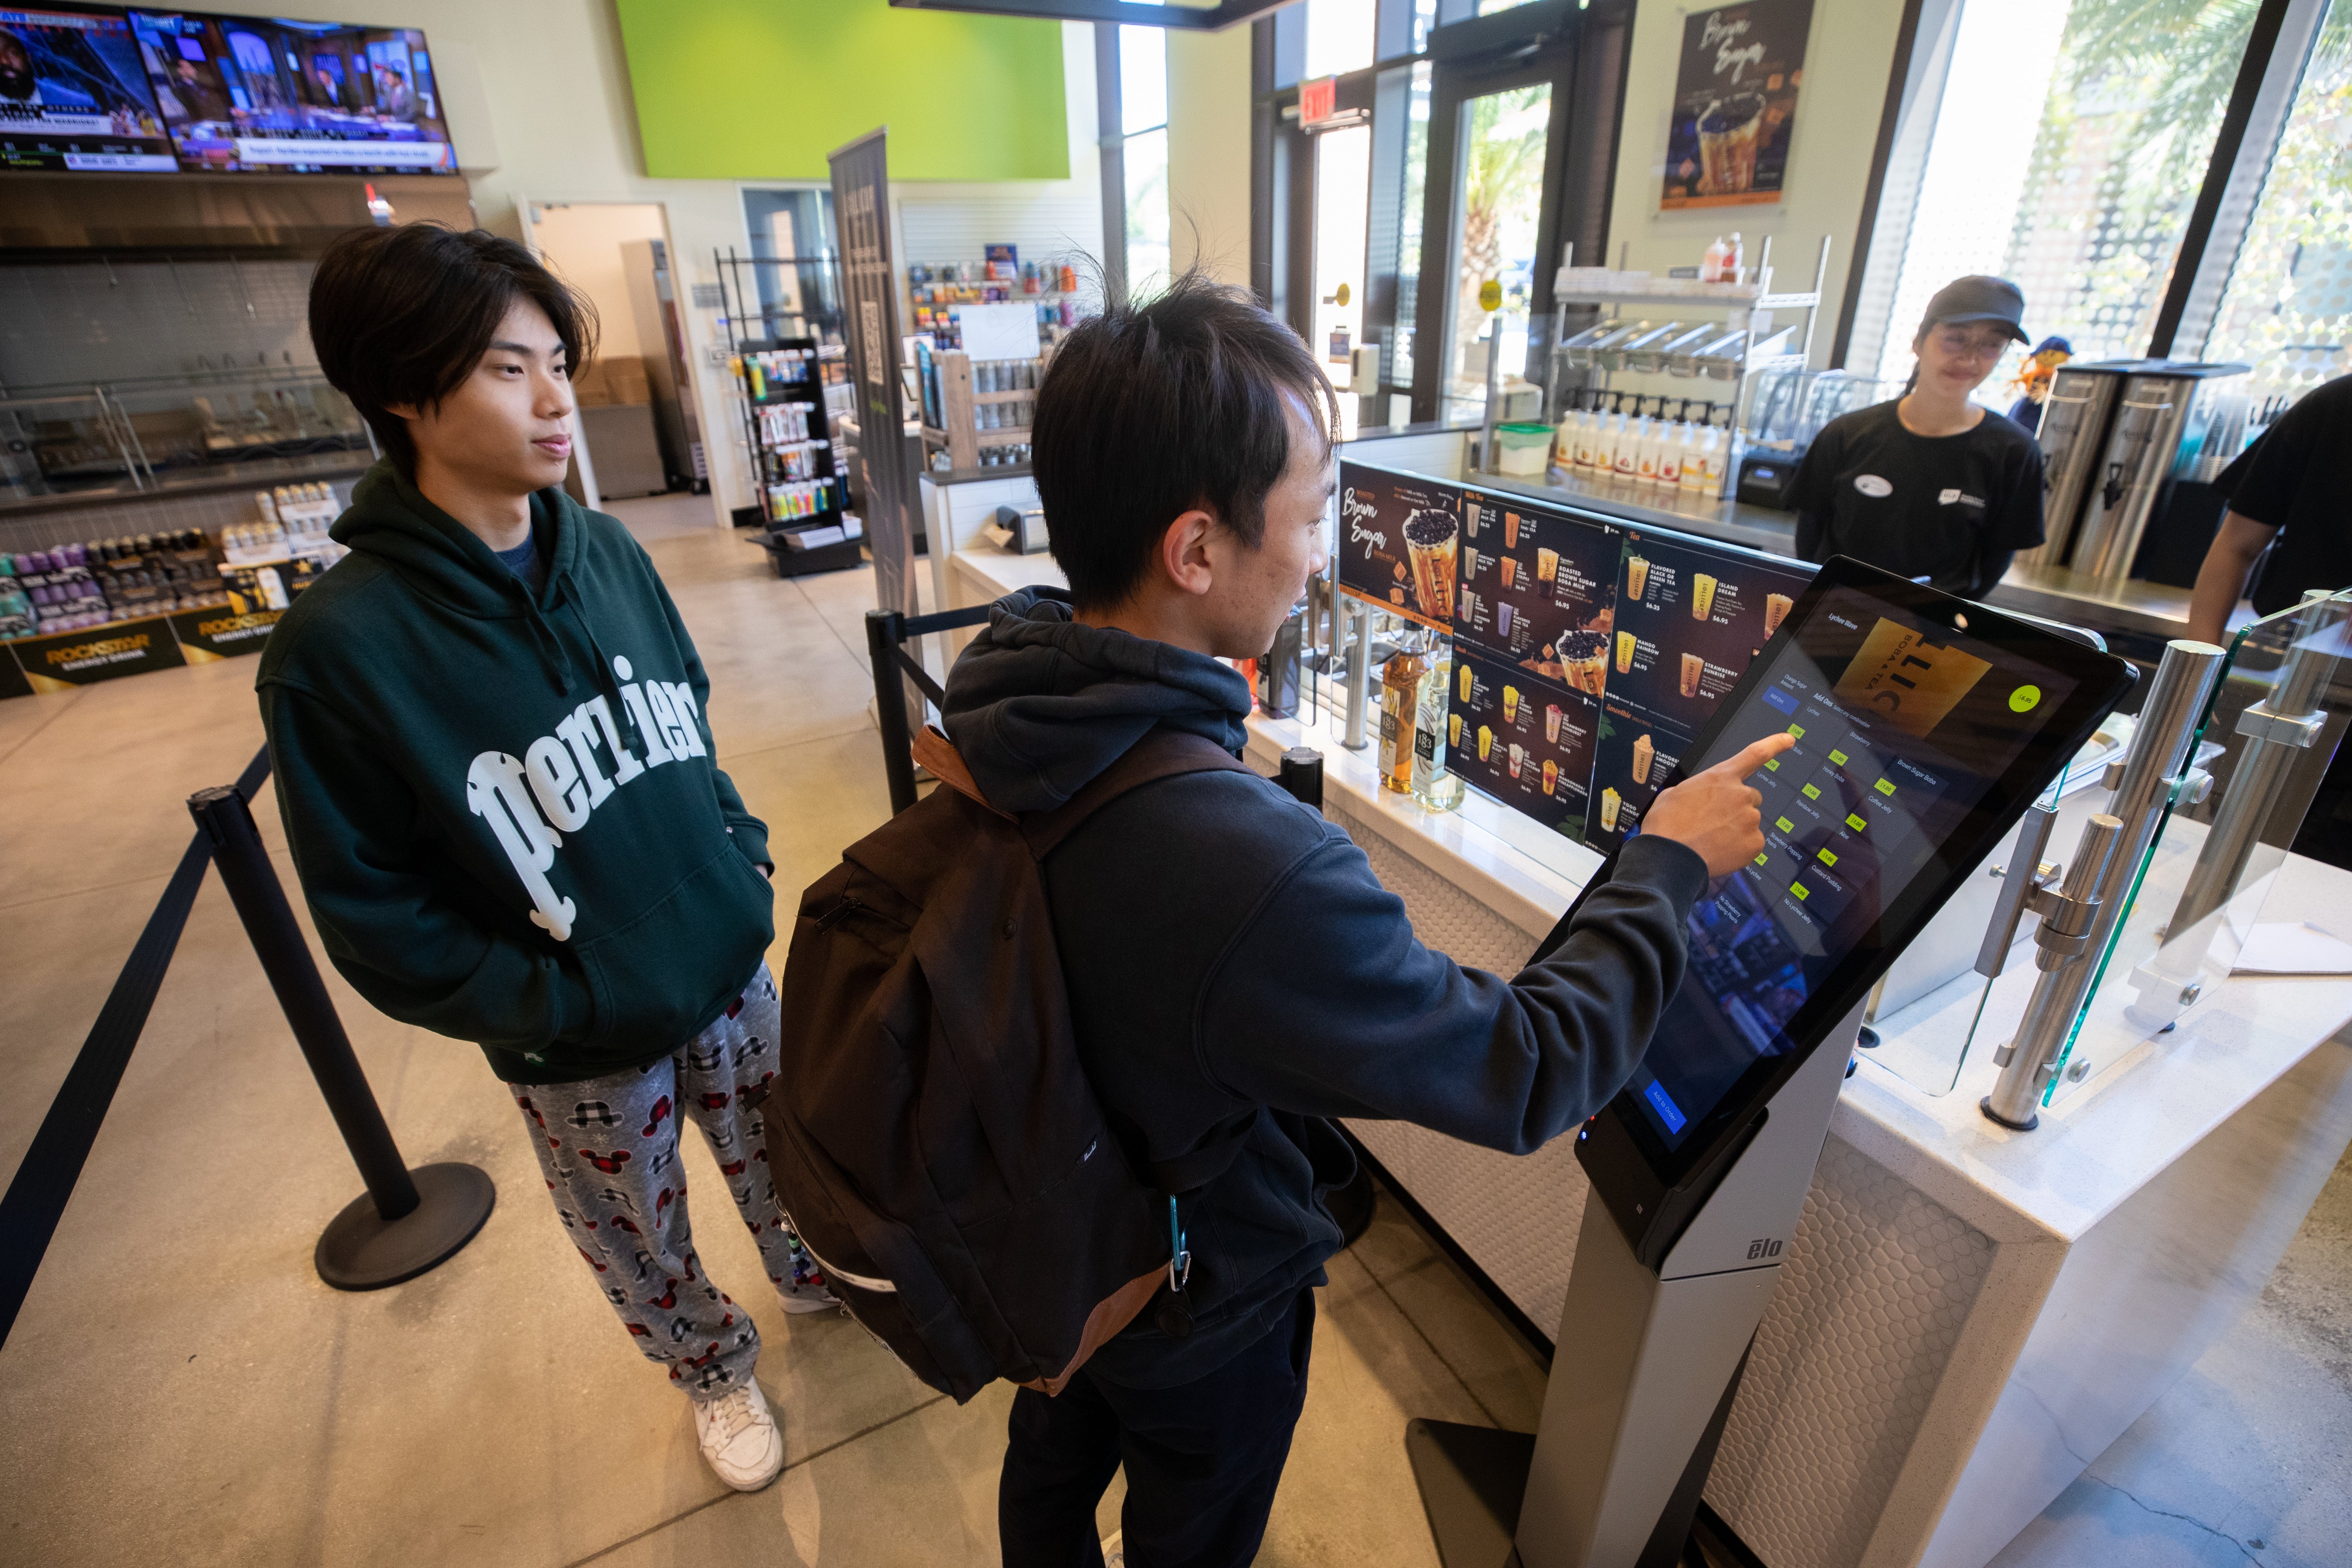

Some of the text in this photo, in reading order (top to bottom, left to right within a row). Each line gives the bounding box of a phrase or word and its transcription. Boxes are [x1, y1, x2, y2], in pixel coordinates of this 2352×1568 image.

[1304, 88, 1328, 121] EXIT
[1465, 491, 1475, 499] Milk
[1342, 487, 1378, 518] Brown
[1351, 515, 1387, 559] Sugar
[1629, 531, 1640, 541] Tea
[1478, 554, 1495, 562] HORCHATA
[1559, 566, 1581, 576] ROASTED
[1651, 564, 1675, 574] FLAVORED
[1558, 577, 1571, 586] BOBA
[1559, 572, 1596, 588] BROWN SUGAR
[1650, 575, 1666, 583] GREEN
[1719, 582, 1738, 591] ISLAND
[1700, 583, 1708, 611] LOLLICUP
[1718, 588, 1736, 597] DREAM
[1555, 600, 1570, 610] $6.95
[1646, 602, 1660, 611] $6.25
[1513, 615, 1531, 624] FLAVORED
[1712, 615, 1728, 625] $6.95
[1828, 613, 1858, 630] Lychee Wave
[46, 634, 150, 665] ROCKSTAR
[1636, 644, 1659, 655] RAINBOW
[1637, 639, 1655, 649] MANGO
[1887, 634, 1913, 662] BOBA
[62, 649, 147, 671] ENERGY DRINK
[1634, 662, 1647, 671] $6.95
[1705, 662, 1738, 677] STRAWBERRY
[1704, 668, 1726, 678] SUNRISE
[1780, 680, 1795, 690] Amount
[1785, 674, 1807, 689] Change Sugar
[1865, 673, 1884, 690] TEA
[1700, 689, 1715, 699] $6.95
[1770, 693, 1779, 701] Add
[2018, 694, 2033, 703] $6.95
[1519, 706, 1532, 715] MANGO
[1606, 704, 1632, 719] Smoothie
[1807, 706, 1820, 717] Lychee
[1813, 693, 1824, 702] Add
[1823, 698, 1834, 707] Ons
[1832, 704, 1844, 714] Select
[1849, 714, 1871, 729] combination
[1517, 725, 1527, 733] $6.95
[1562, 721, 1587, 735] STRAWBERRY
[1562, 725, 1582, 737] SUNBURST
[1792, 727, 1802, 735] $1.00
[1850, 731, 1871, 747] Strawberry
[1493, 742, 1508, 753] TROPICAL
[1559, 745, 1571, 754] $6.95
[1793, 746, 1803, 756] Boba
[1524, 758, 1536, 766] LYCHEE
[1833, 753, 1844, 763] $1.00
[1524, 763, 1540, 773] VOLCANO
[1897, 759, 1936, 785] Brown Sugar Boba
[1757, 771, 1777, 788] Lychee Jelly
[1822, 766, 1845, 783] Honey Boba
[1521, 784, 1531, 793] $6.95
[1558, 779, 1588, 796] PINEAPPLENADA
[1806, 787, 1817, 796] $1.00
[1879, 782, 1892, 792] $1.00
[467, 655, 707, 941] perrier
[1556, 795, 1567, 804] $6.95
[1623, 801, 1637, 811] YOGO
[1796, 799, 1821, 819] Rainbow Jelly
[1868, 796, 1893, 815] Coffee Jelly
[1779, 820, 1791, 830] $1.00
[1850, 818, 1862, 828] $1.00
[1839, 830, 1850, 840] Aloe
[1765, 837, 1777, 849] Pearls
[1770, 832, 1803, 861] Strawberry Popping
[1822, 852, 1834, 863] $1.00
[1749, 868, 1762, 881] Lychee
[1811, 865, 1842, 892] Custard Pudding
[1794, 886, 1805, 897] $1.00
[1715, 900, 1739, 924] Popping Pearls
[1723, 899, 1741, 918] Strawberry
[1788, 901, 1804, 917] Lychee
[1801, 913, 1812, 924] Jelly
[1653, 1091, 1663, 1102] Add
[1664, 1106, 1677, 1122] Order
